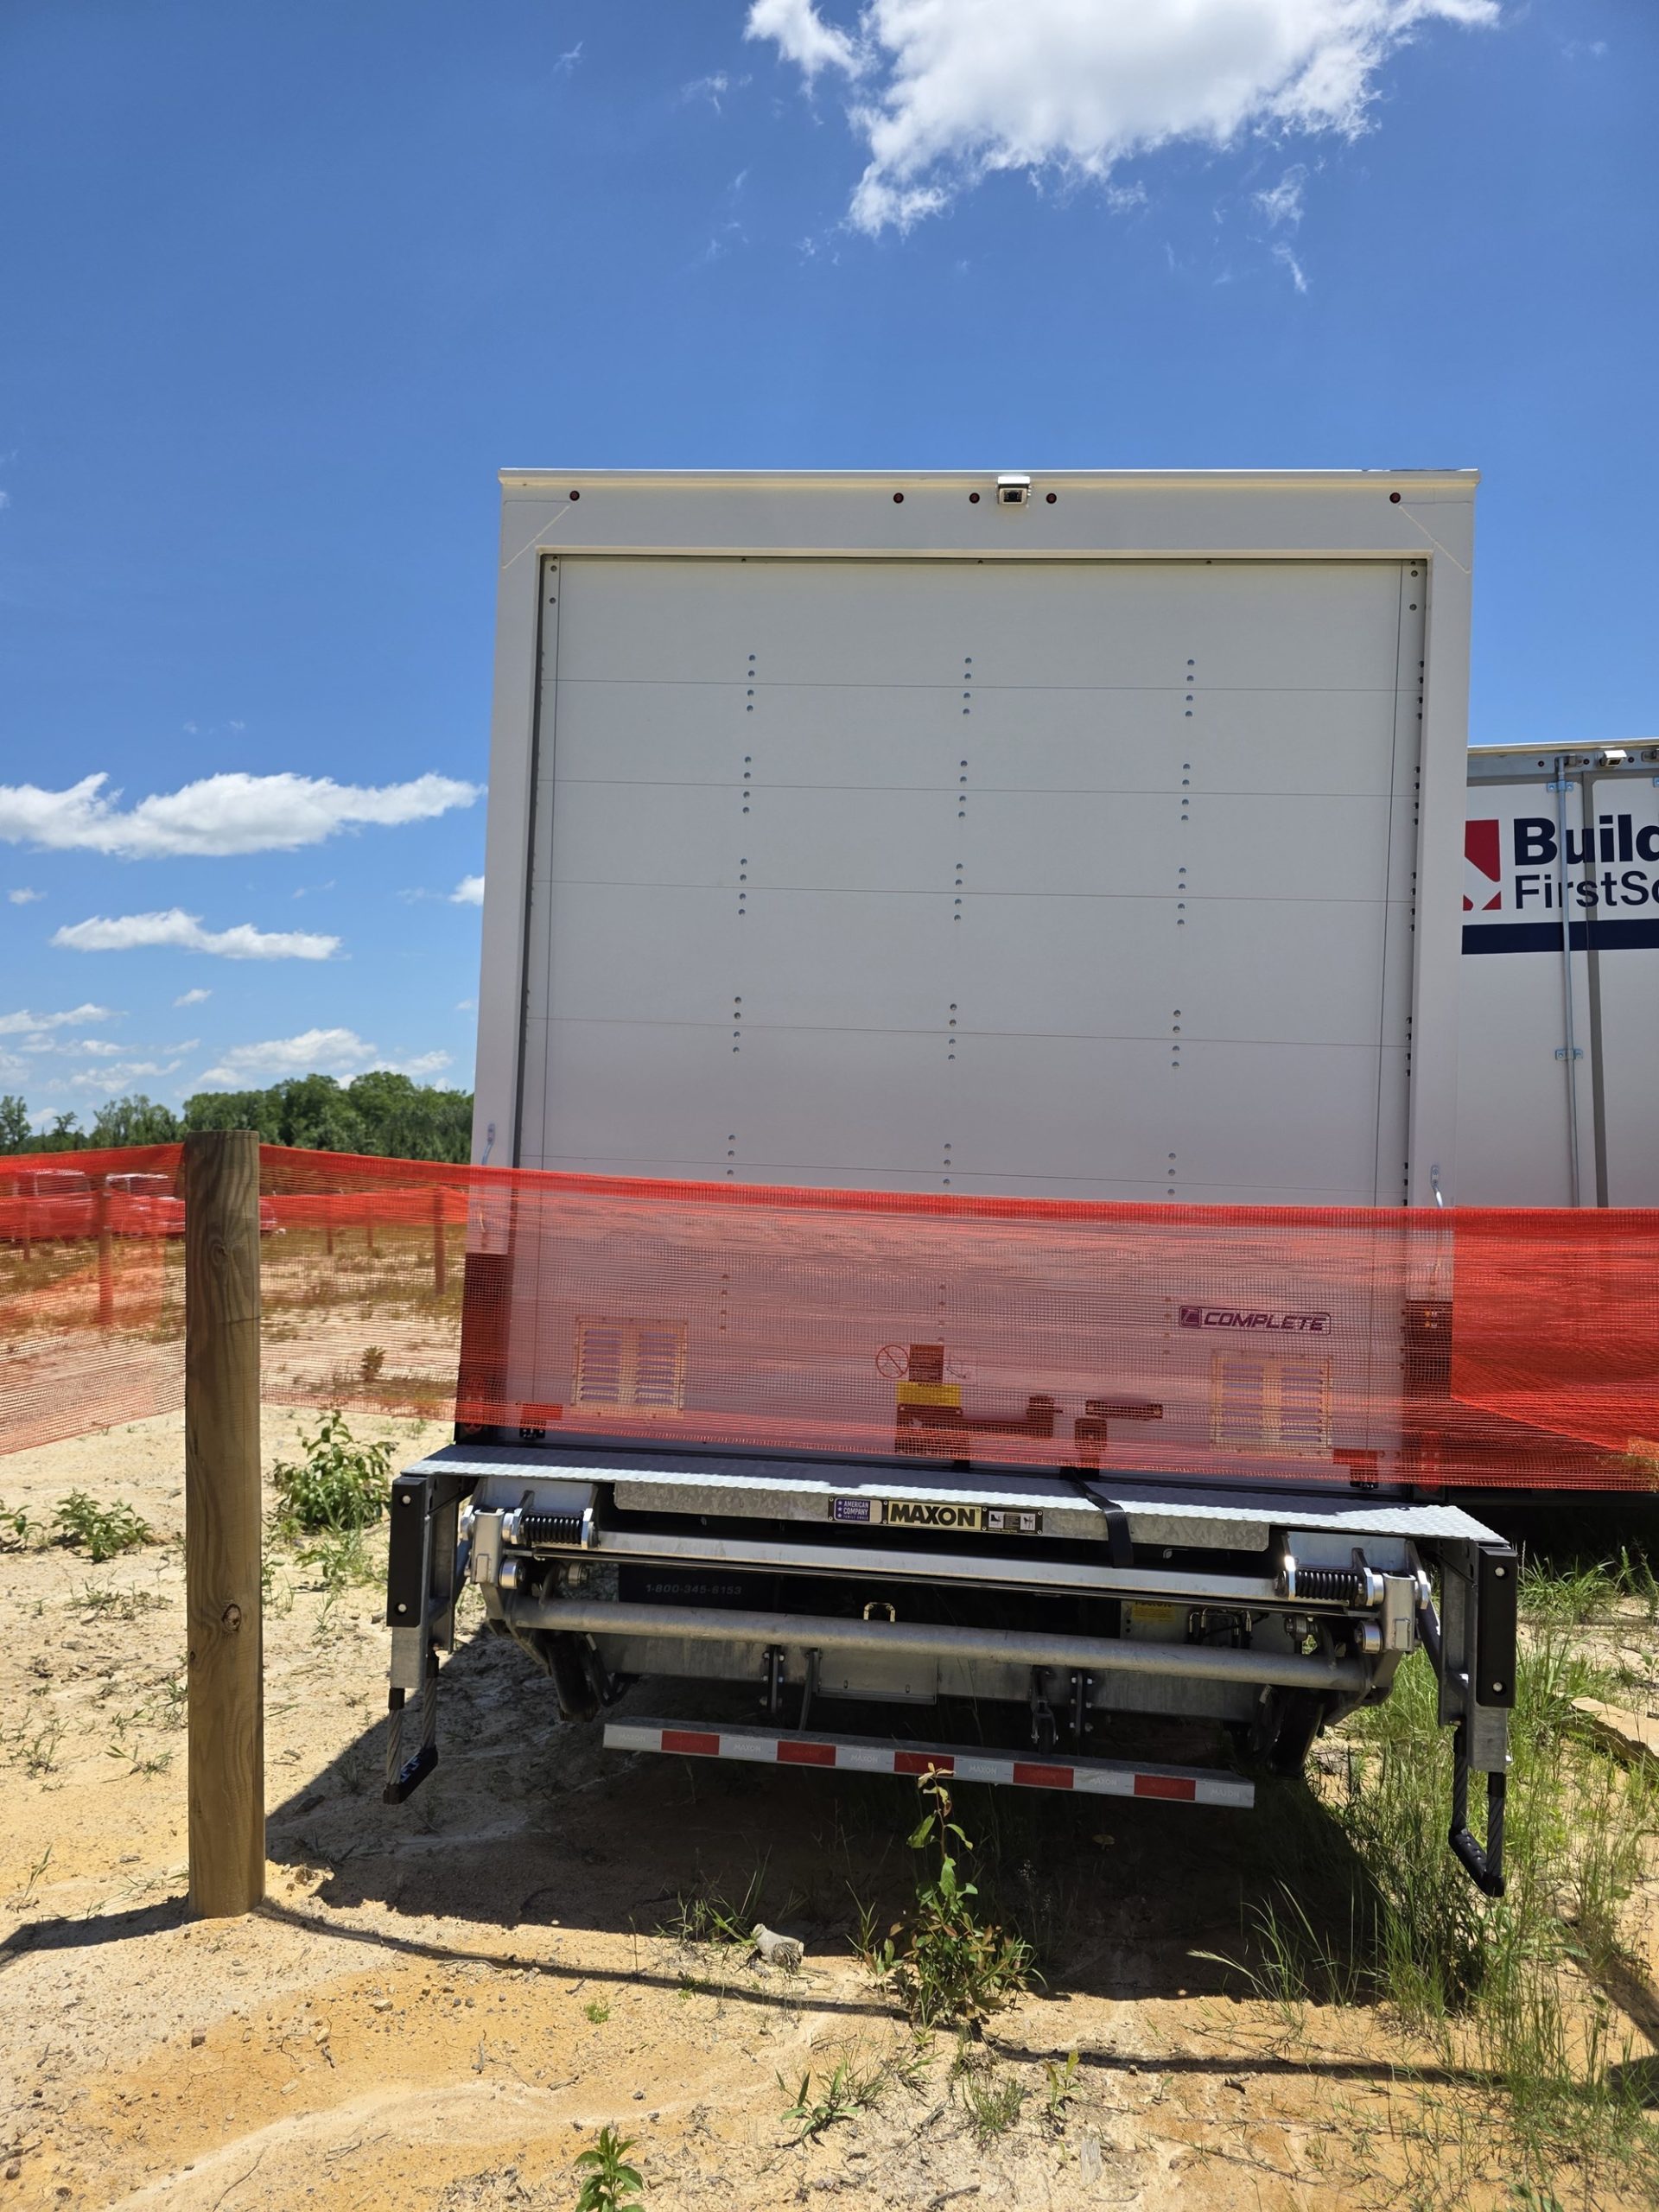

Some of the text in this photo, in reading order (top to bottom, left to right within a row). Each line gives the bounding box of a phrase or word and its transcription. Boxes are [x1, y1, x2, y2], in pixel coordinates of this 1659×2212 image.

[1515, 870, 1659, 910] FirstS
[1204, 1312, 1327, 1332] COMPLETE
[843, 1500, 869, 1509] AMERICAN
[842, 1507, 869, 1516] COMPANY
[890, 1503, 976, 1527] MAXON
[733, 1743, 761, 1753] MAXON
[849, 1753, 879, 1764] MAXON
[968, 1764, 997, 1775] MAXON
